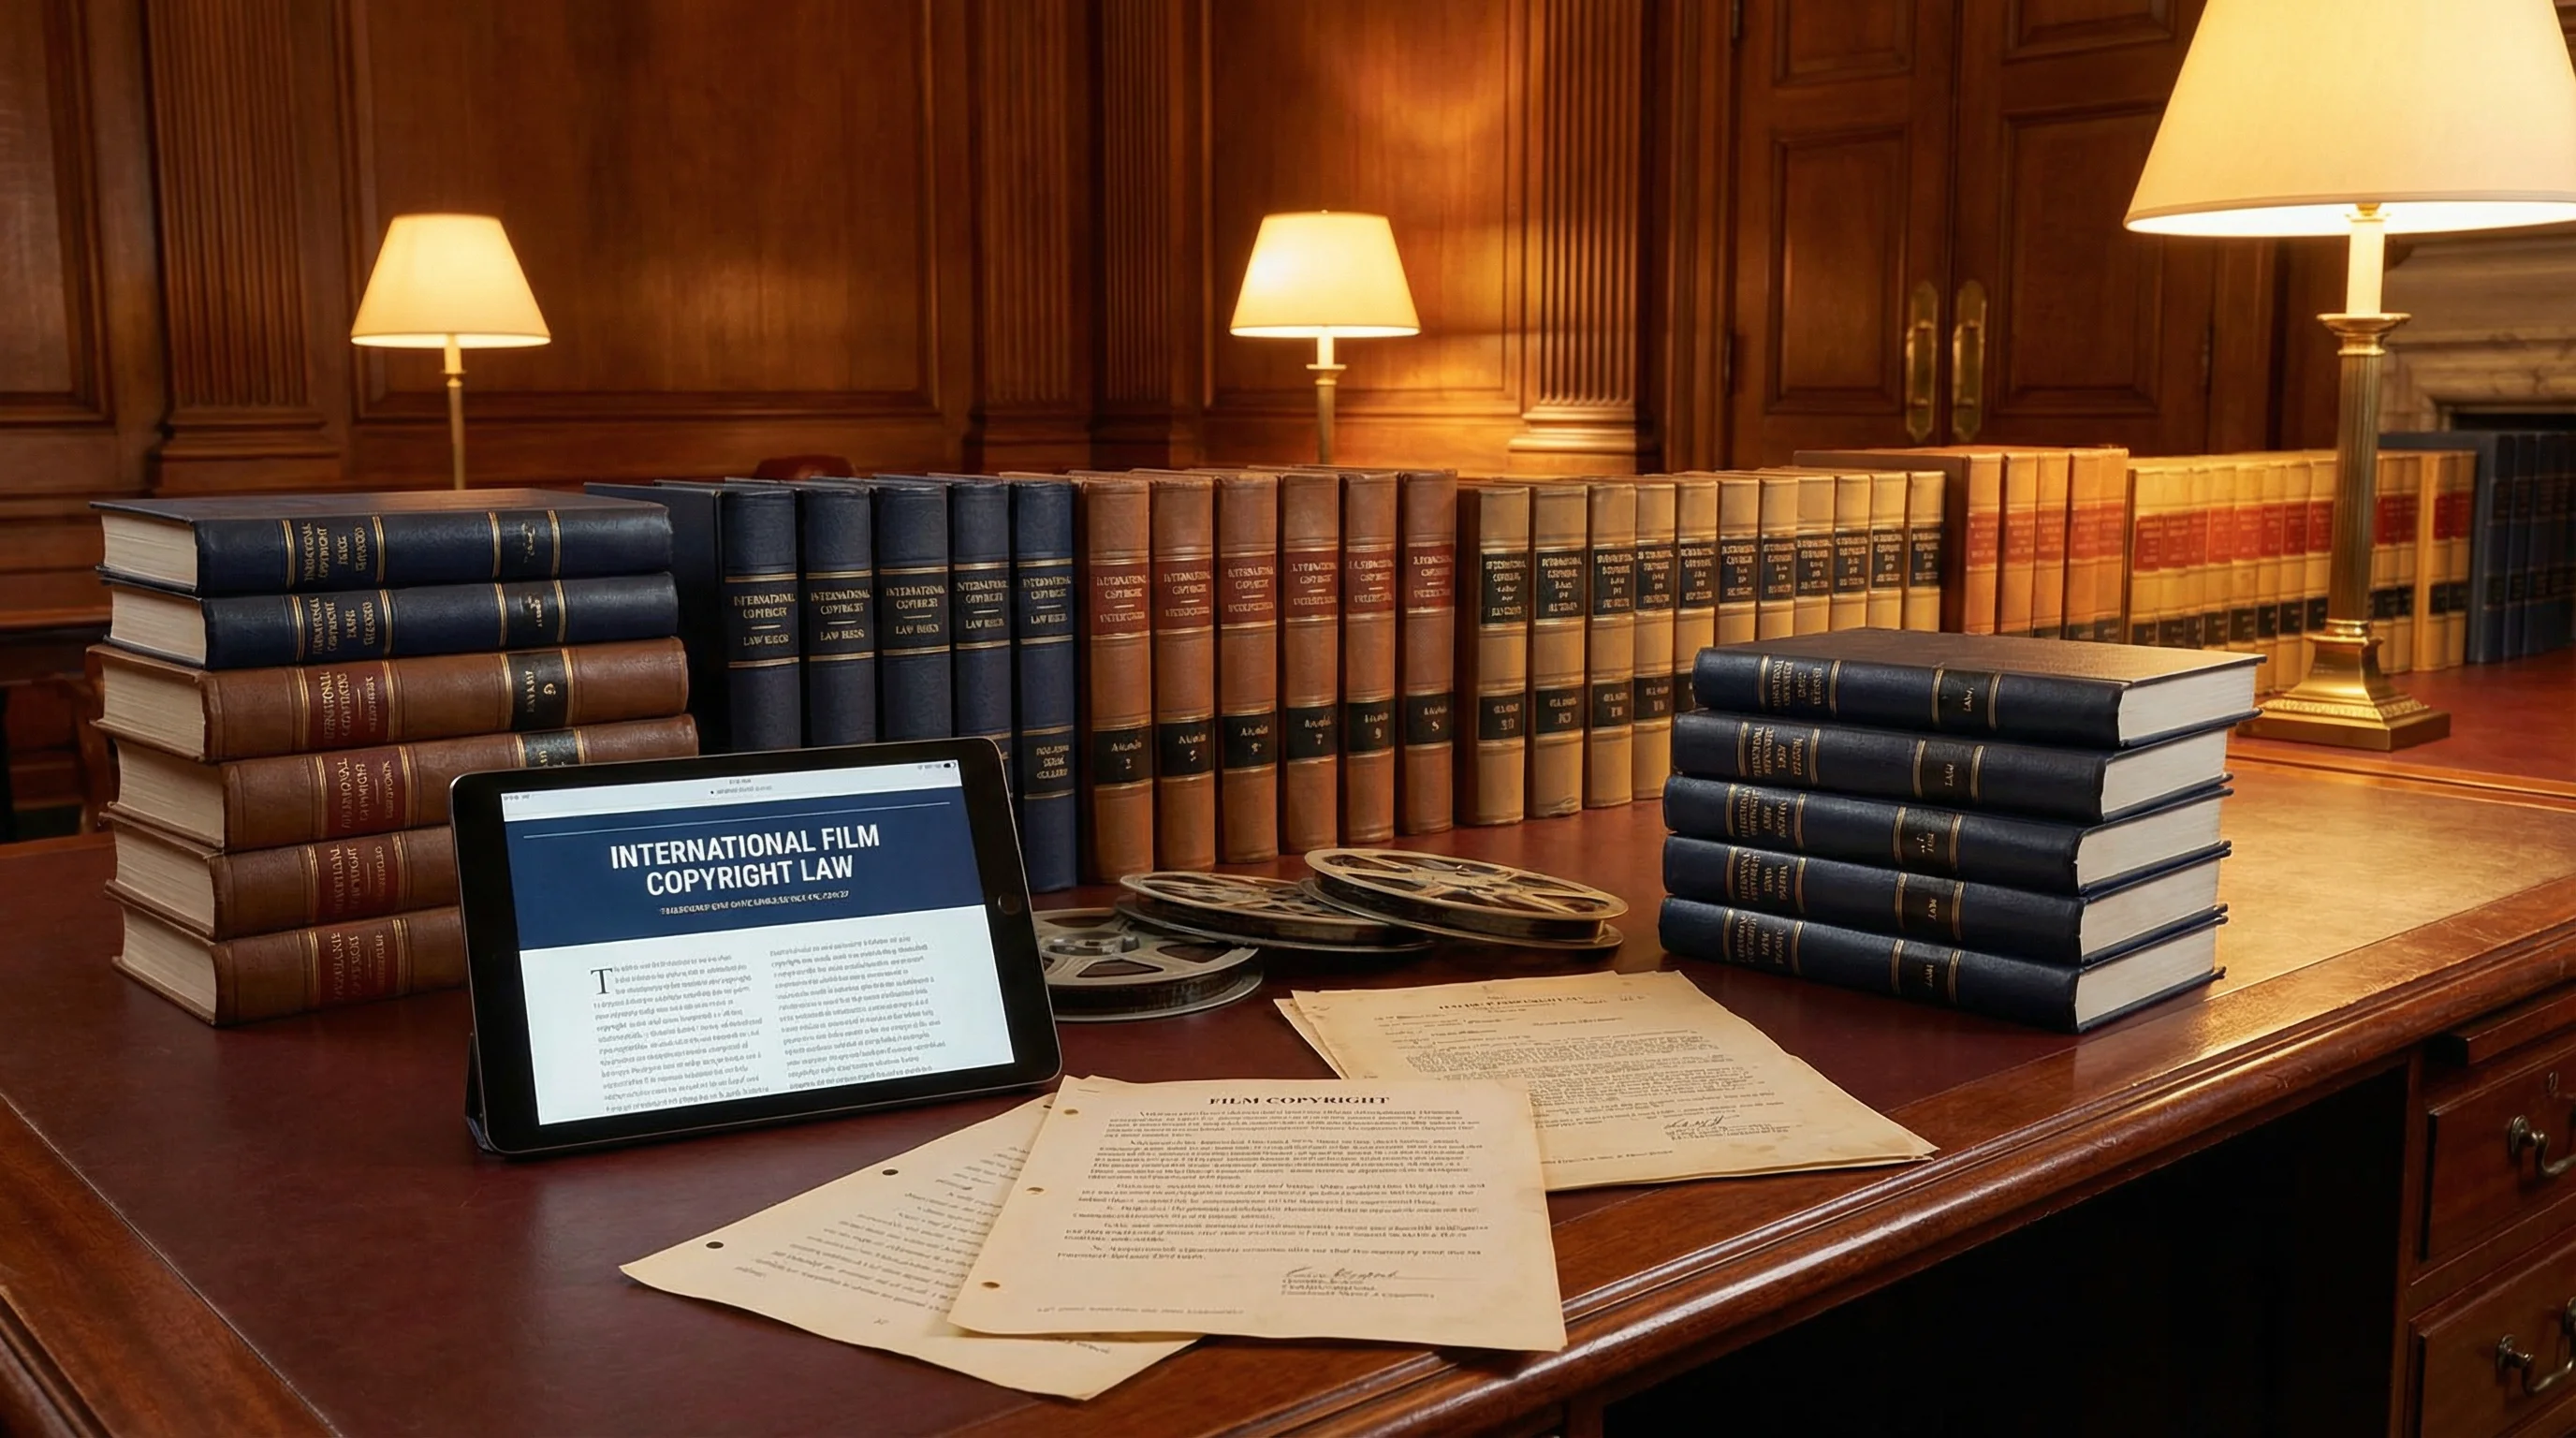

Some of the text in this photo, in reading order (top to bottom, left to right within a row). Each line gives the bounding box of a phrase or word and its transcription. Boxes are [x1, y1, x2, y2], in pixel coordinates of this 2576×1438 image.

[610, 824, 880, 869] INTERNATIONAL FILM
[646, 855, 853, 896] COPYRIGHT LAW
[1266, 1096, 1390, 1105] COPYRIGHT
